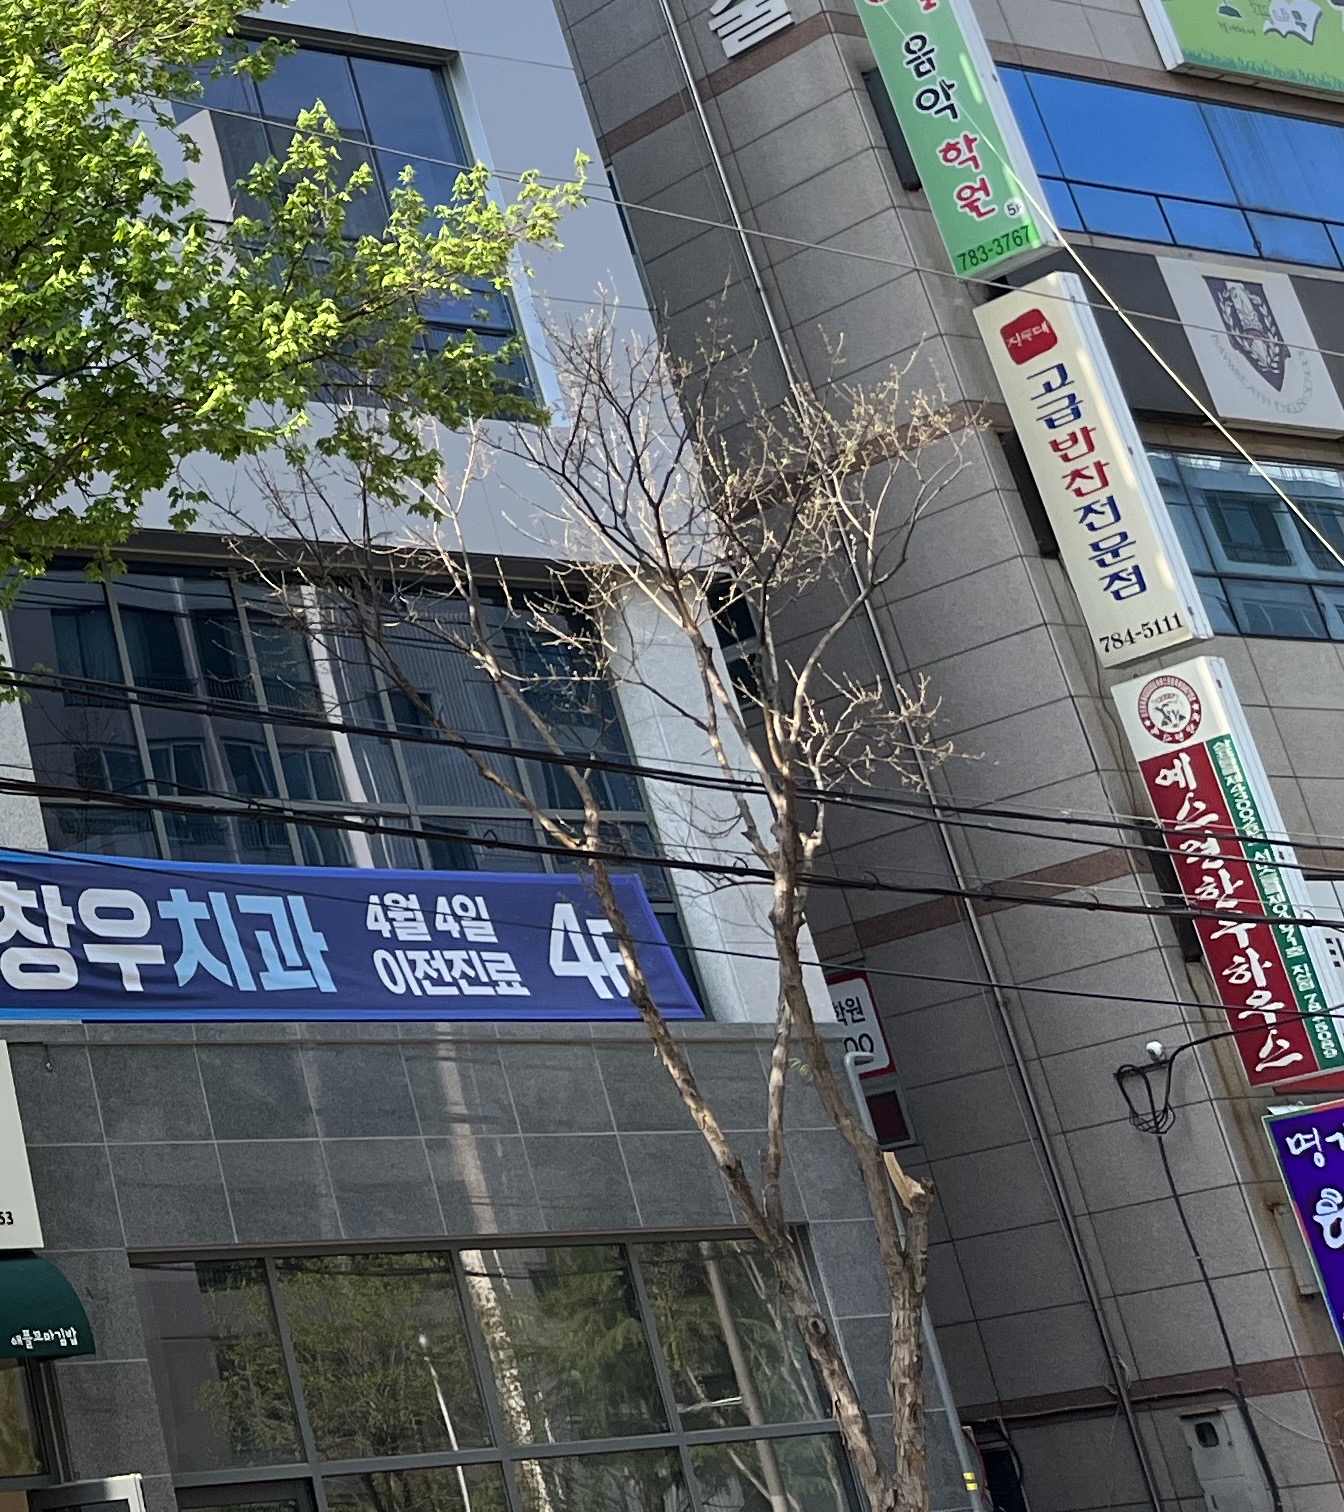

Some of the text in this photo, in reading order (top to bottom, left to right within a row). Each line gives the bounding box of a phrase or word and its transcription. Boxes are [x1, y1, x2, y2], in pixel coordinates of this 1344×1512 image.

[957, 225, 1032, 272] 783-3767
[1099, 611, 1184, 654] 784-5111
[366, 892, 499, 943] 4월 4일
[373, 949, 531, 997] 이전진료
